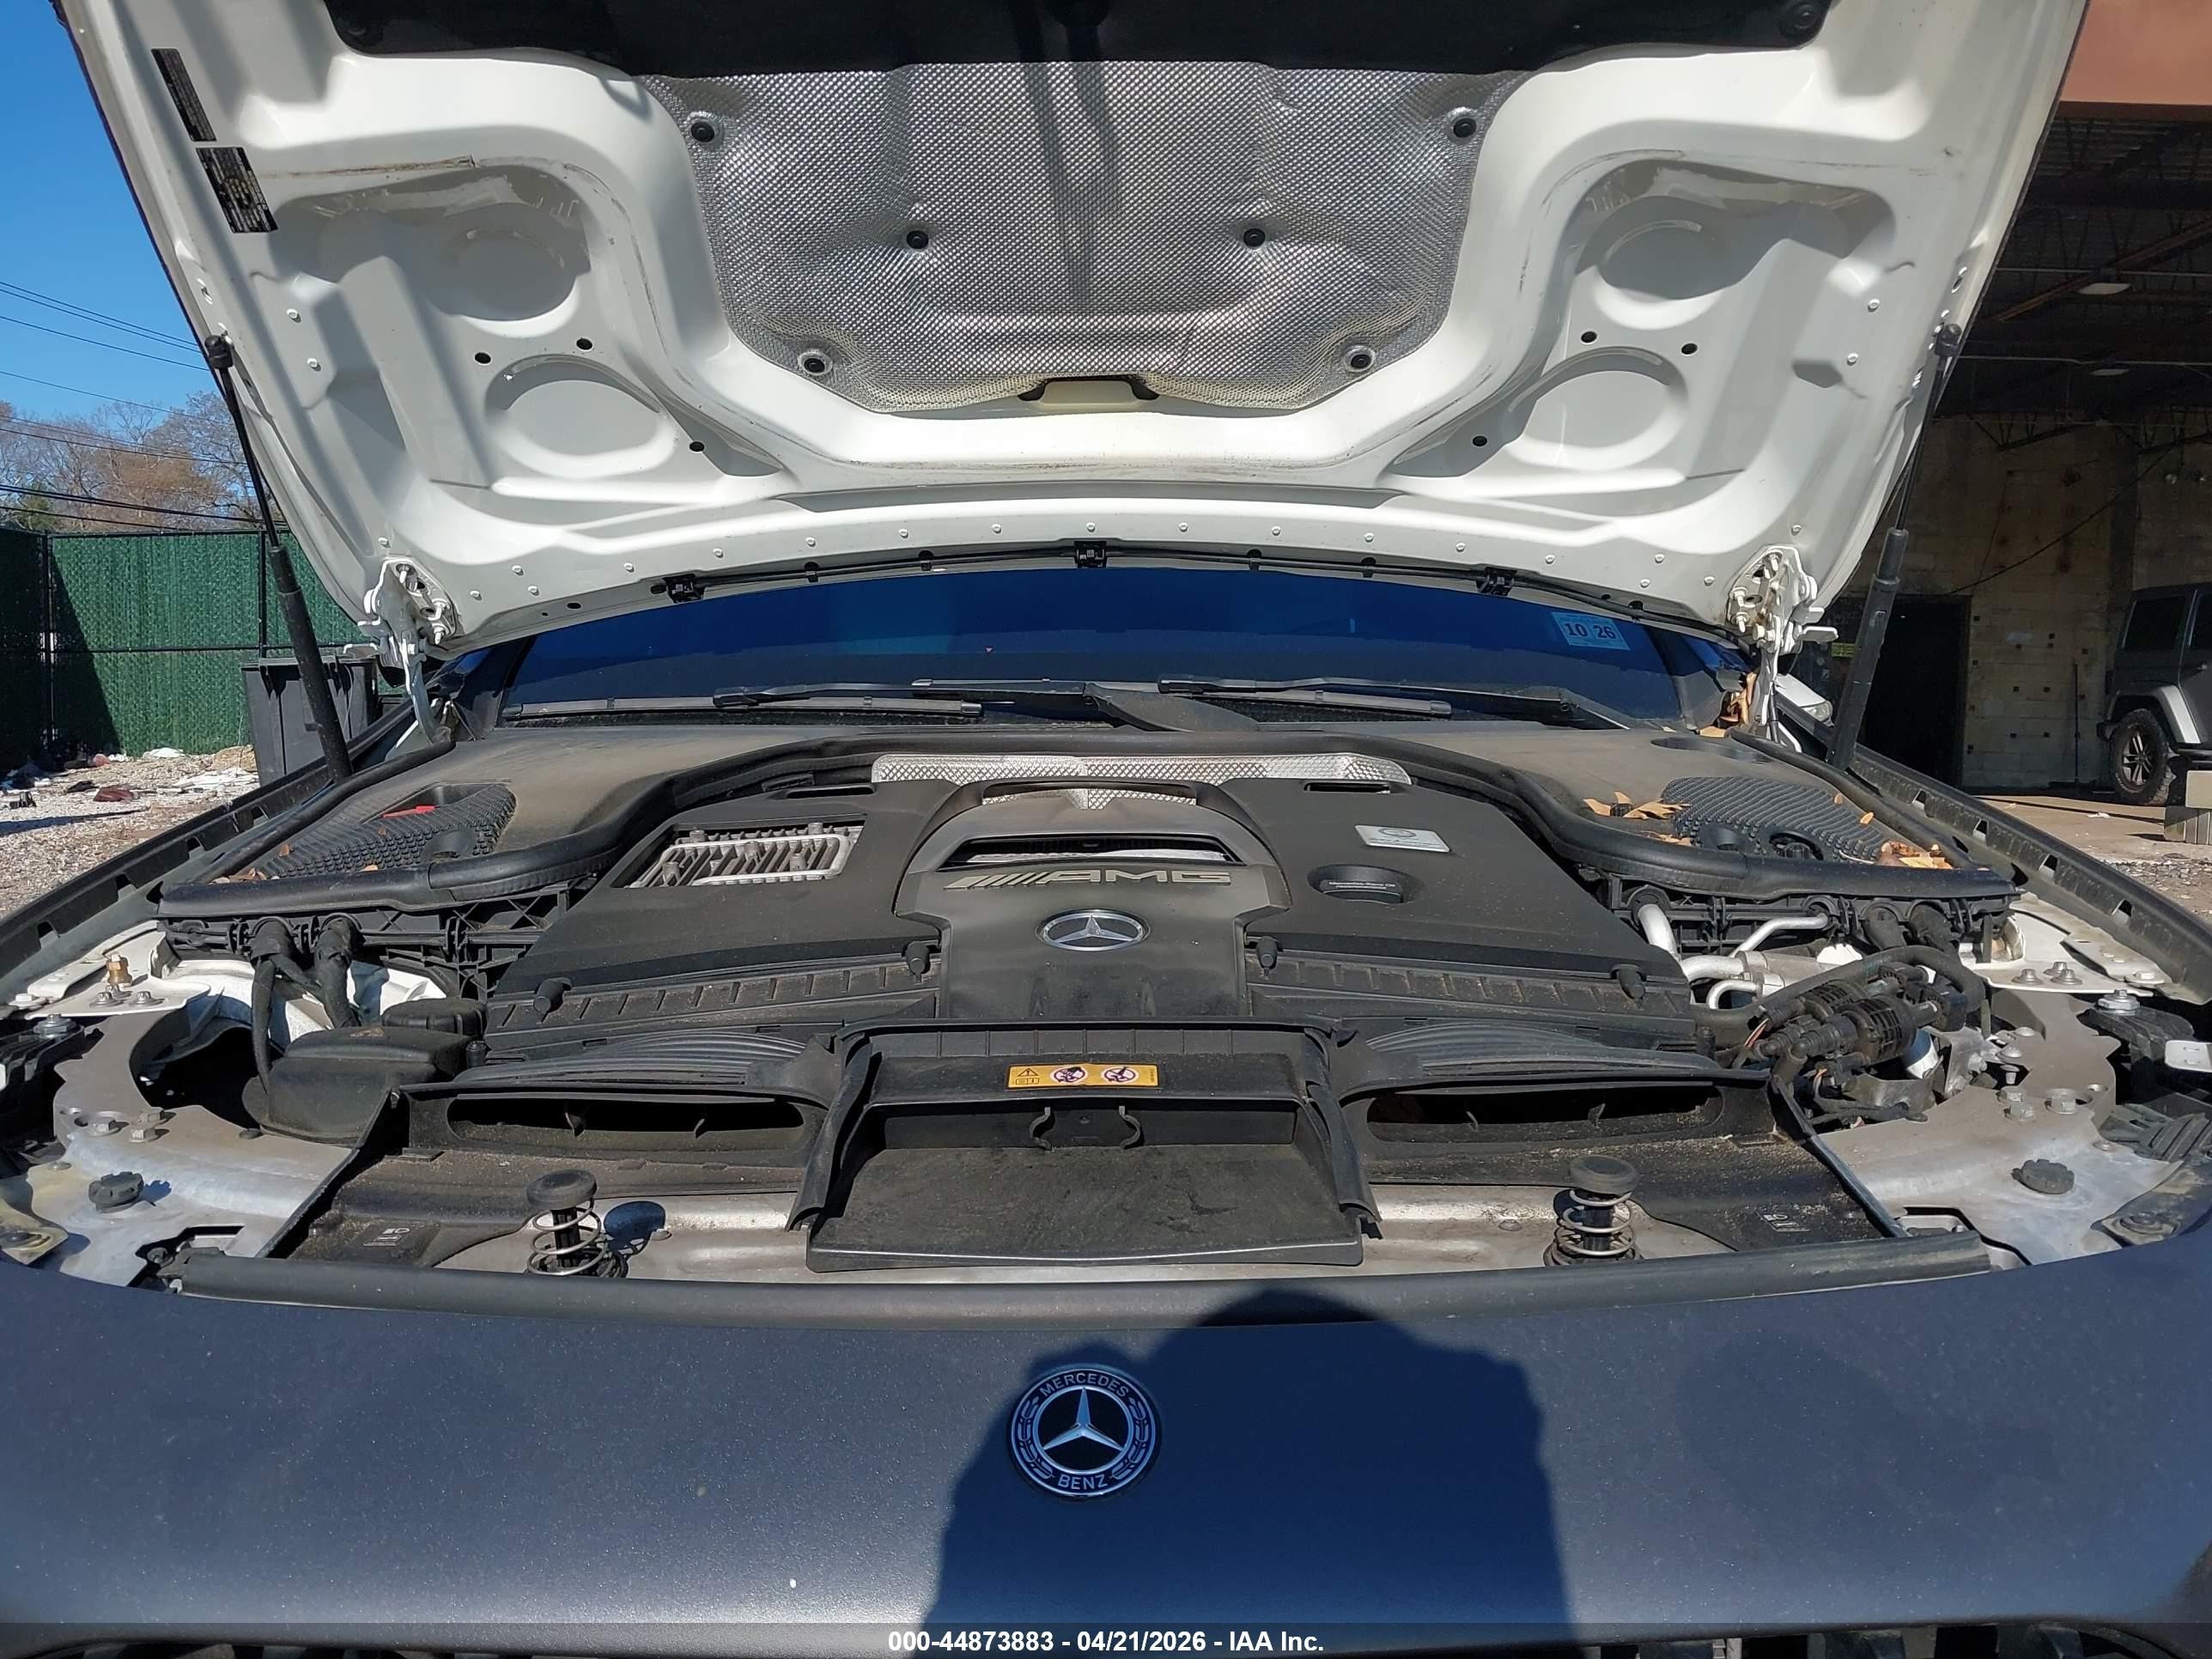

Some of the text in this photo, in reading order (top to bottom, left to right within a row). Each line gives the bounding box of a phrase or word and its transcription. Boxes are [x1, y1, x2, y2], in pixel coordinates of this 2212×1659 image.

[1565, 623, 1617, 640] 10 26
[1036, 869, 1231, 885] AMG
[1040, 1372, 1130, 1398] MERCEDES
[1057, 1474, 1109, 1491] BENZ
